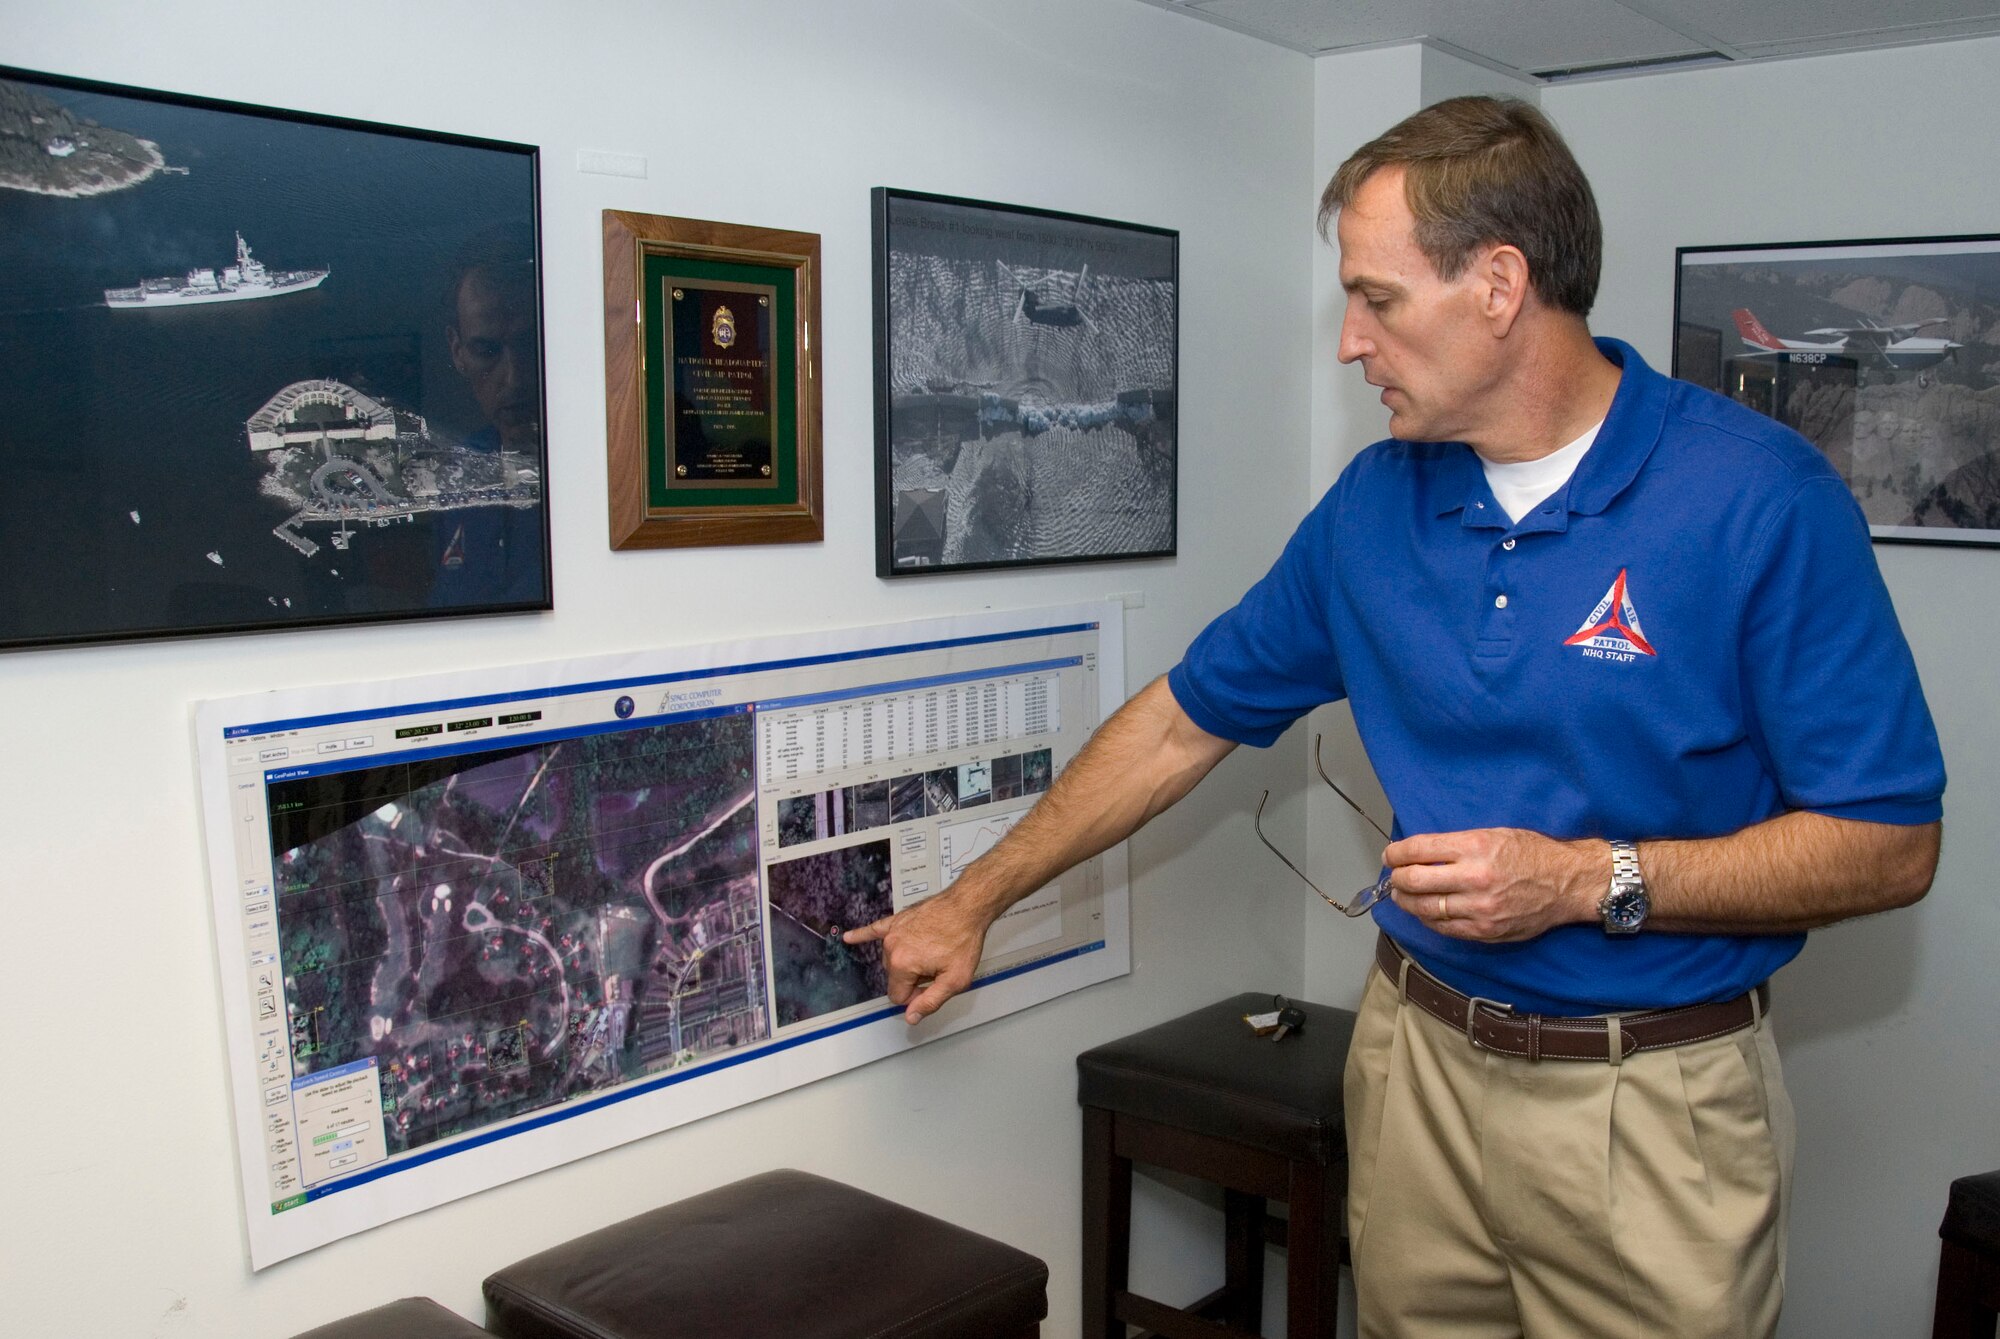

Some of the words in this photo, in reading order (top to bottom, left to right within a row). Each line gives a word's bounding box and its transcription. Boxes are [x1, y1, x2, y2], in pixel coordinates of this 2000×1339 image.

[1789, 353, 1827, 363] N638CP
[1589, 600, 1610, 624] CIVIL
[1626, 606, 1637, 624] AIR
[1593, 638, 1631, 650] PATROL
[1582, 648, 1604, 659] NHQ
[1605, 651, 1636, 662] STAFF
[670, 692, 688, 702] SPACE
[688, 688, 722, 700] COMPUTER
[670, 698, 715, 711] CORPORATION
